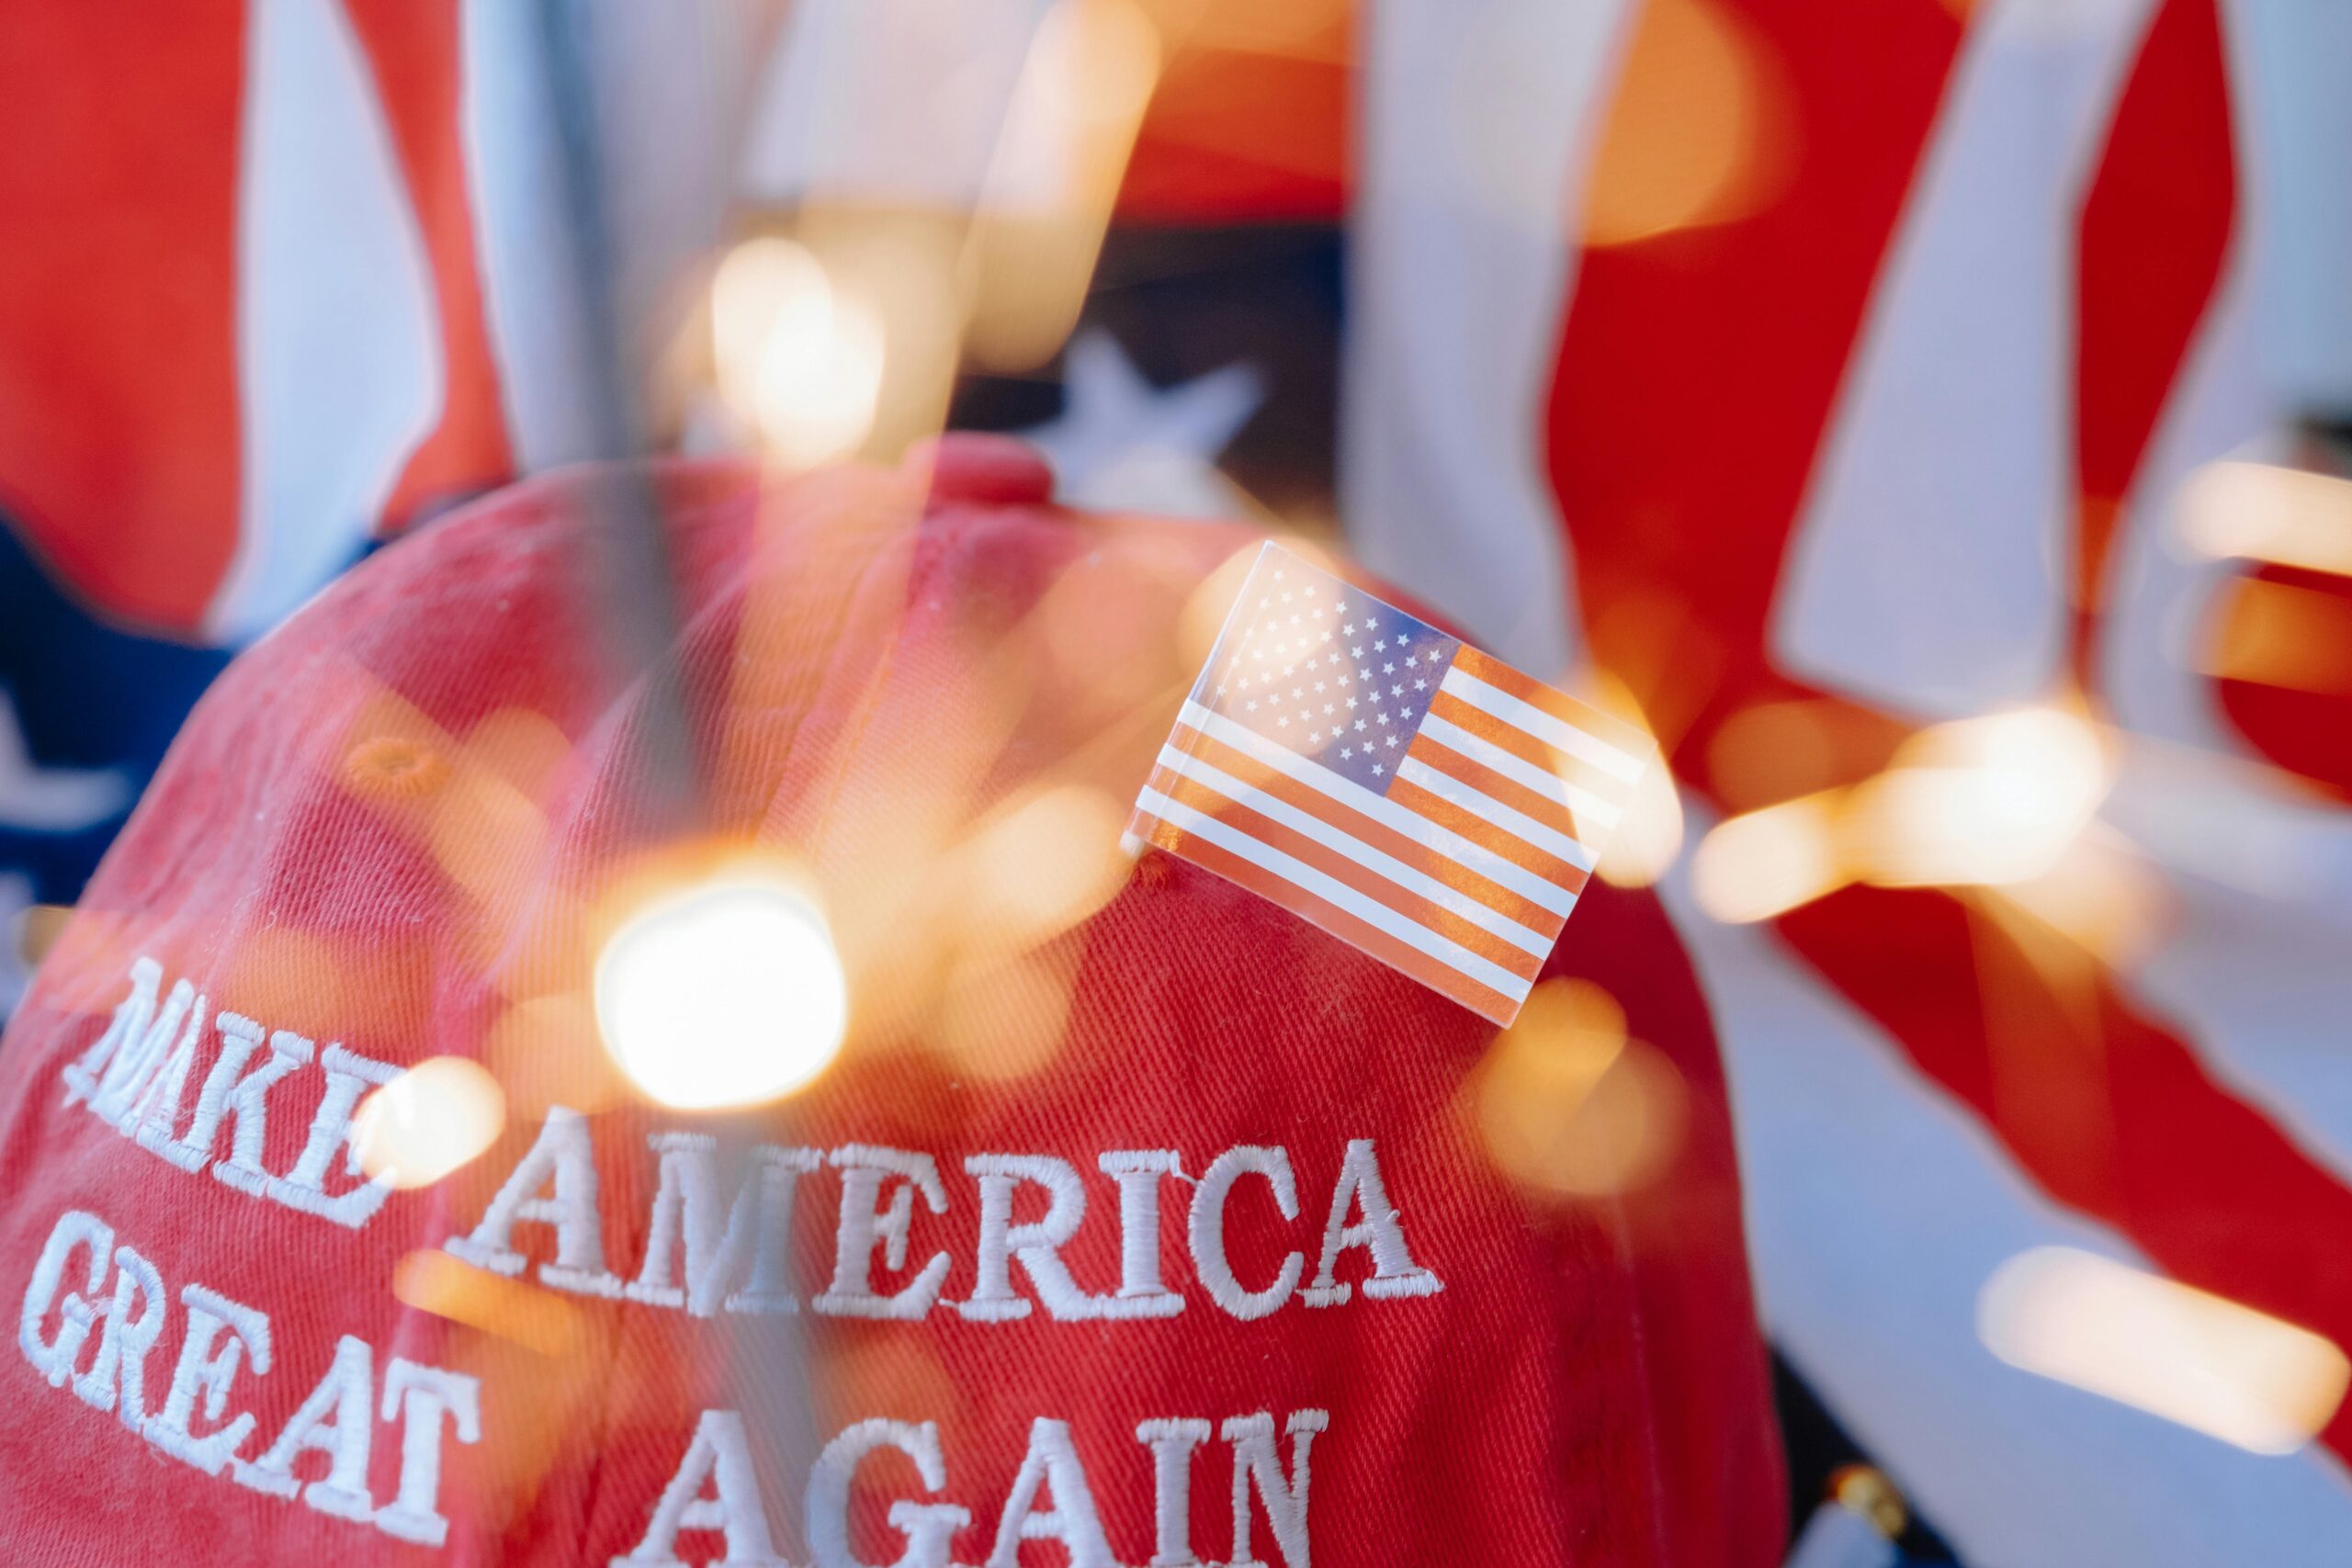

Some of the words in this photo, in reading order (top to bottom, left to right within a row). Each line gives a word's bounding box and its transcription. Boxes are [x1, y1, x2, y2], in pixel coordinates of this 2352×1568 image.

[443, 1105, 1445, 1323] AMERICA
[19, 1210, 481, 1547] GREAT
[608, 1408, 1329, 1568] AGAIN
